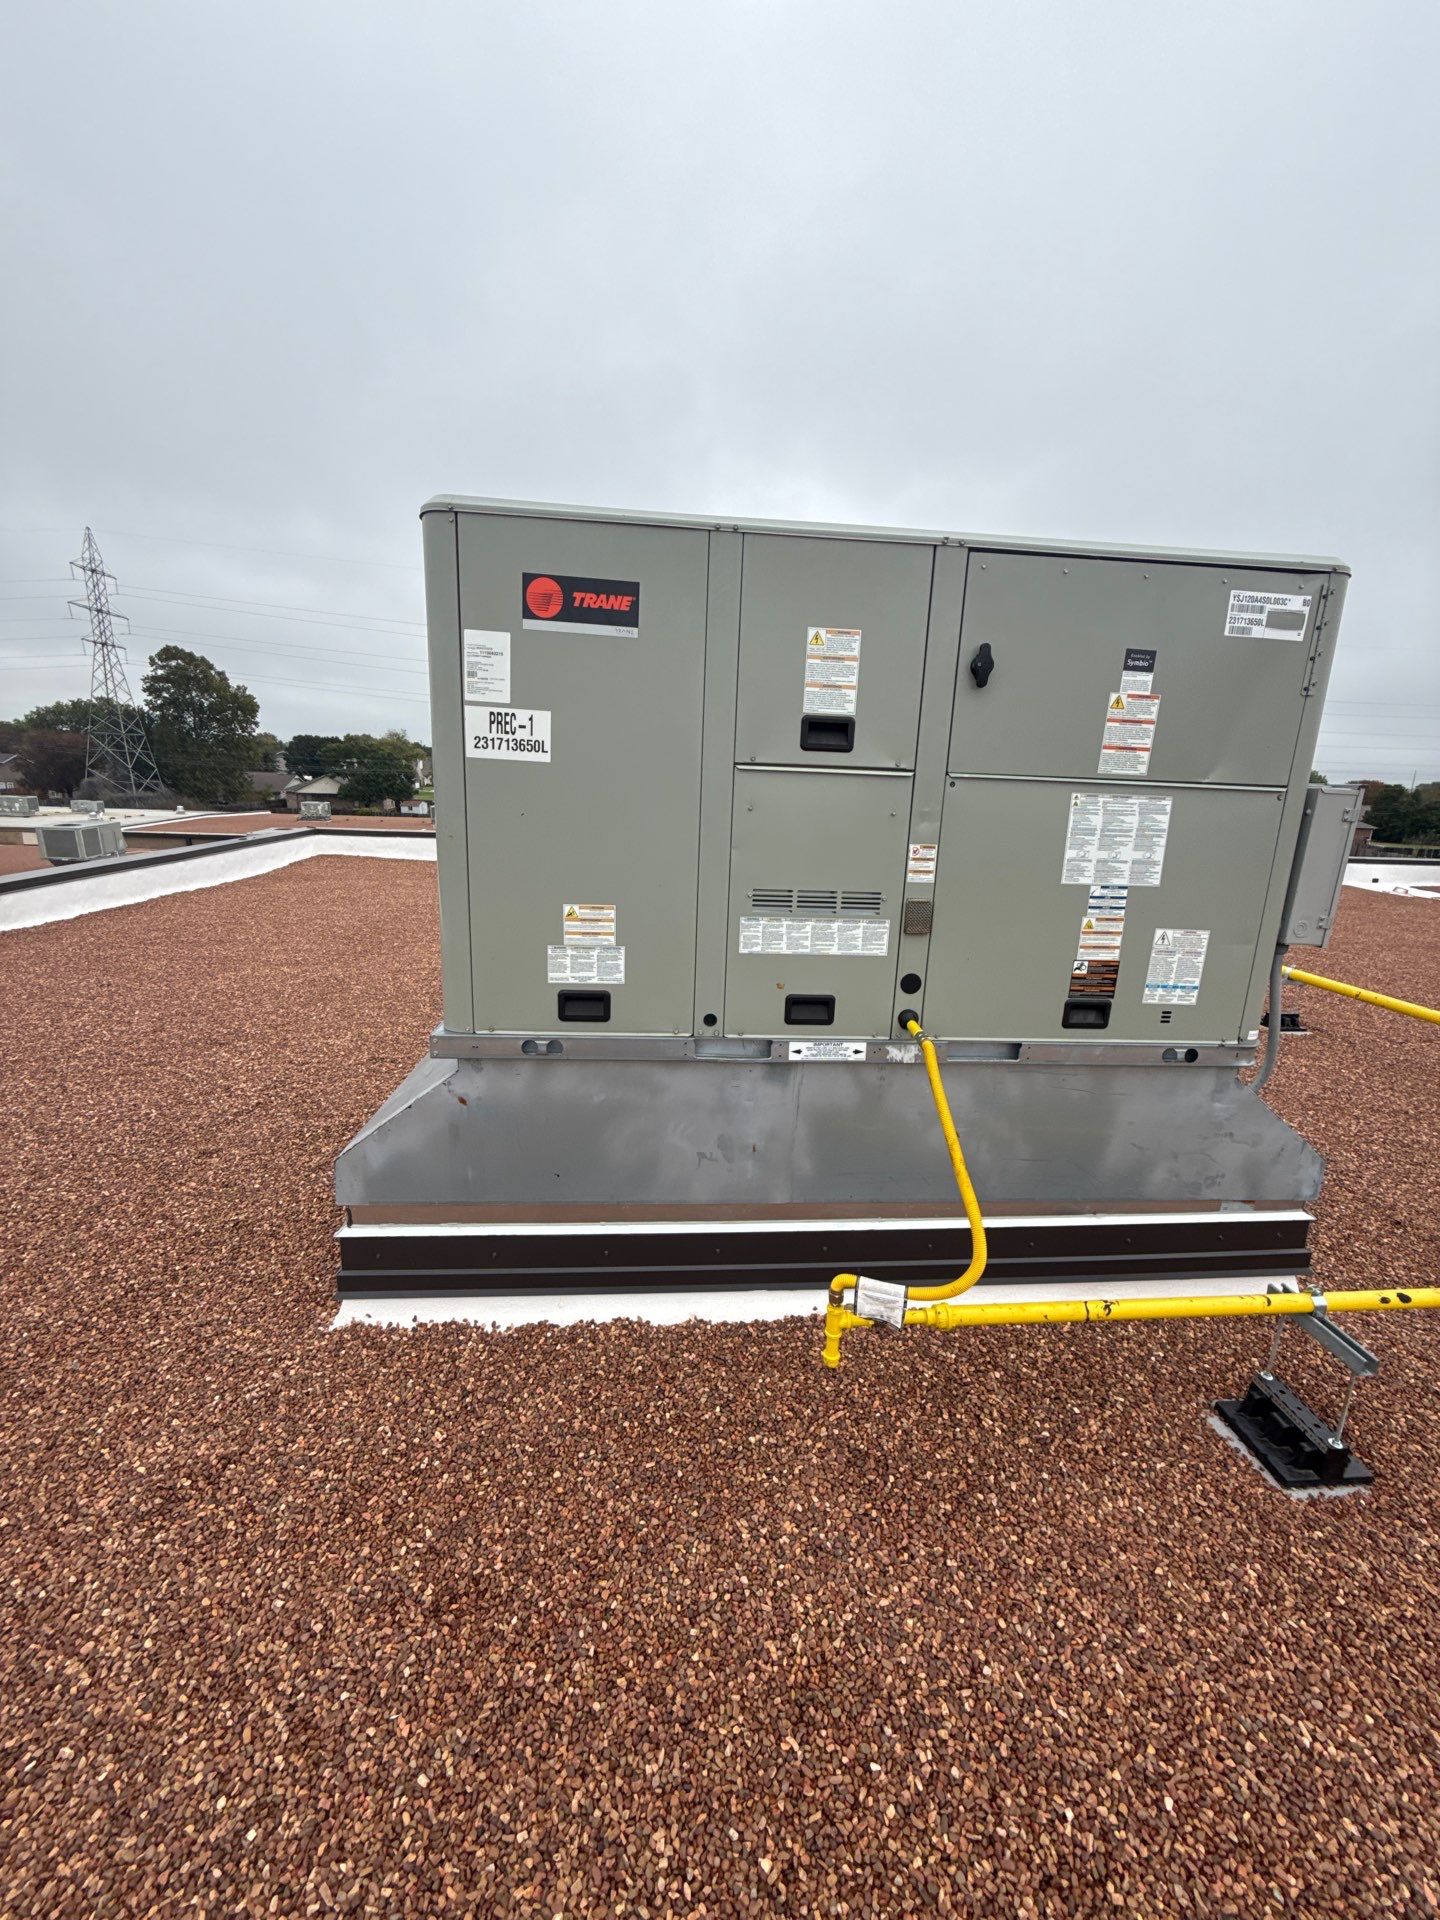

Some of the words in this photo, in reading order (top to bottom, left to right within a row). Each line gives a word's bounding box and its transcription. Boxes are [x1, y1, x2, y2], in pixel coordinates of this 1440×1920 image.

[573, 592, 633, 610] TRANE
[1228, 616, 1265, 626] 231713650L
[474, 736, 549, 753] 231713650L
